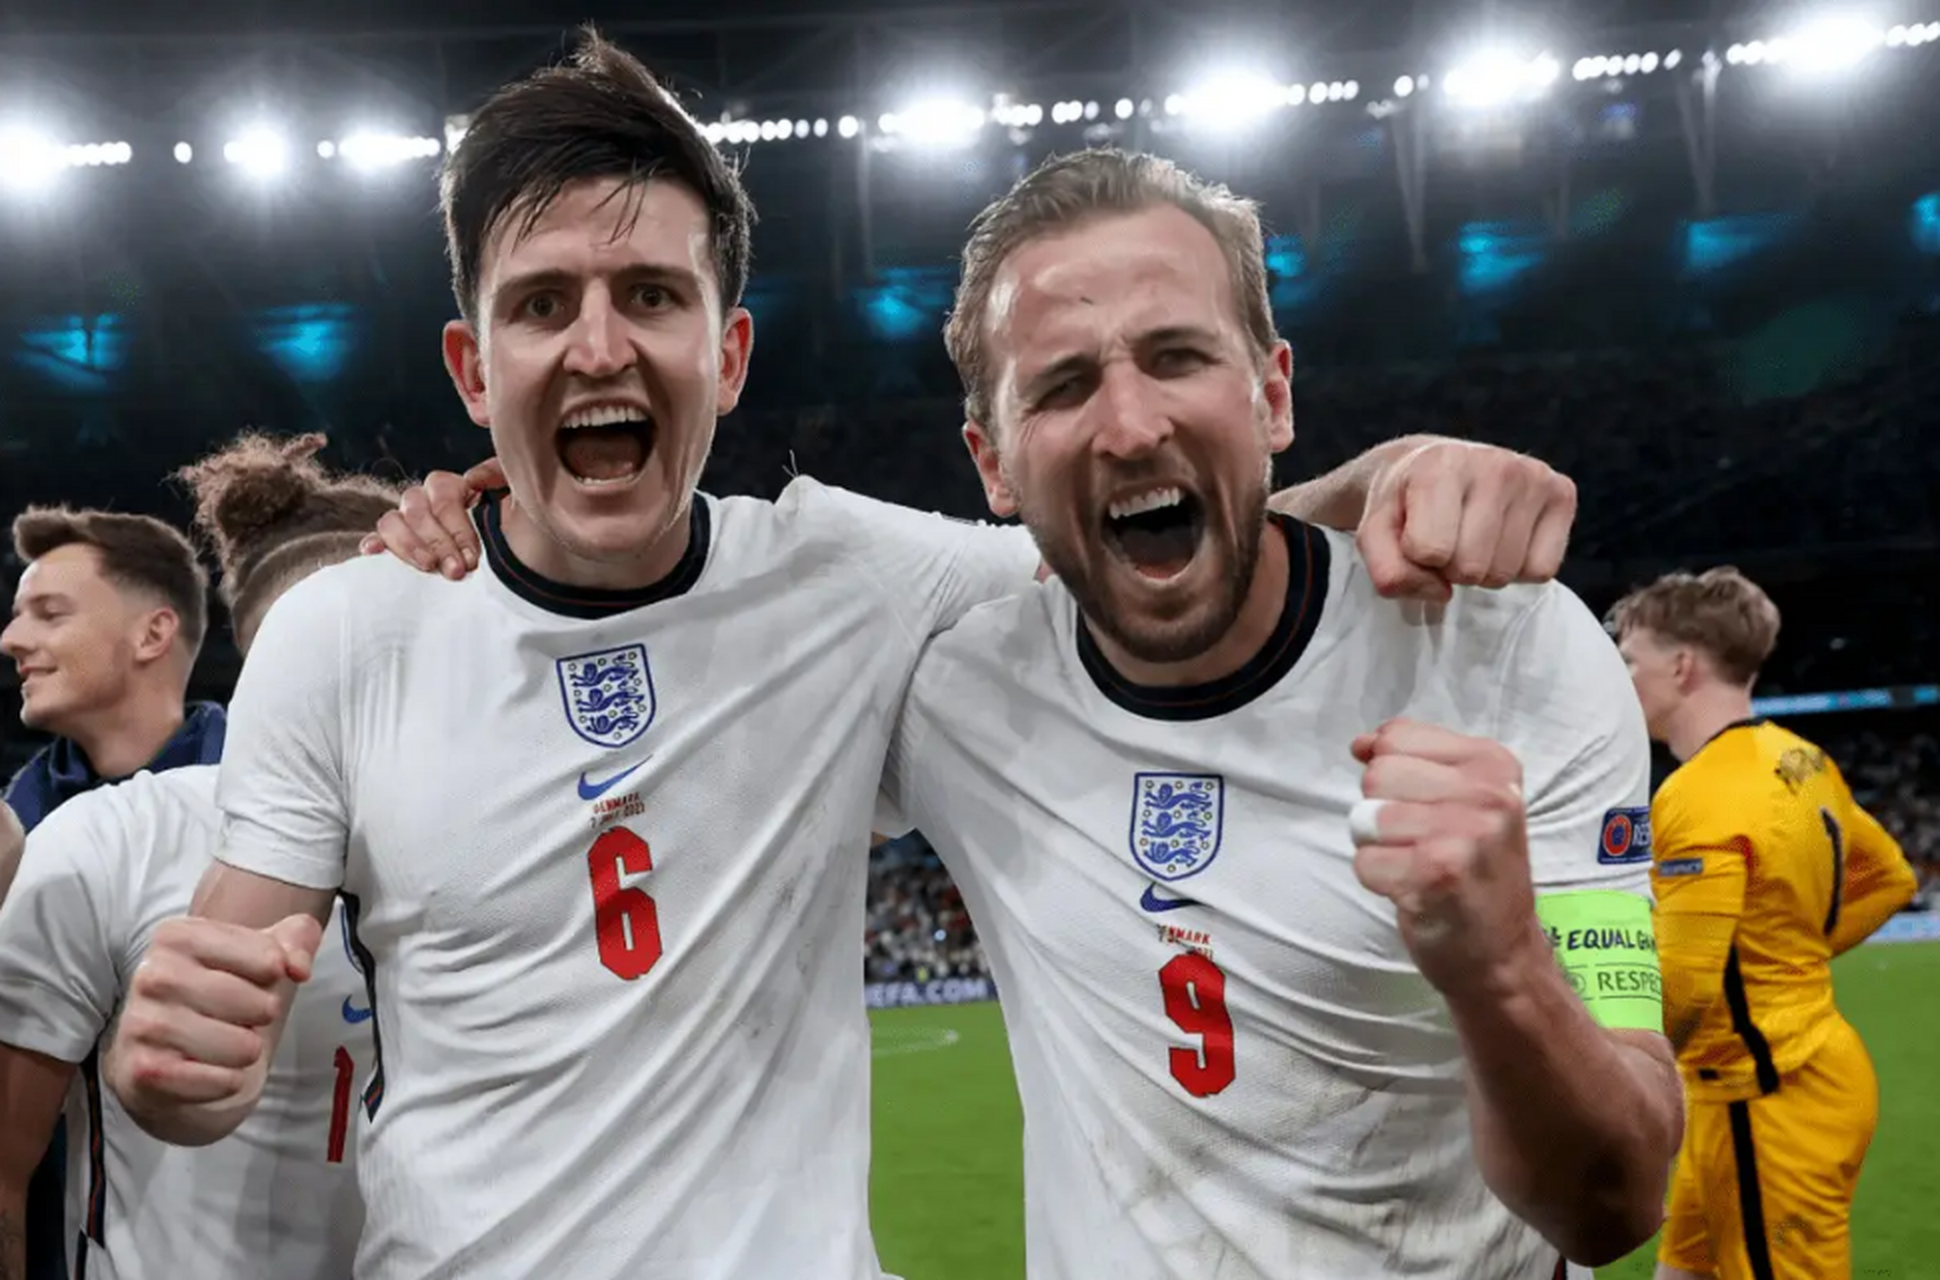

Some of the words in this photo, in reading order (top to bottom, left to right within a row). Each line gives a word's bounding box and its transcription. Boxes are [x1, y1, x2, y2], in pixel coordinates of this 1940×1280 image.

[587, 825, 663, 981] 6
[1820, 806, 1842, 936] 1
[1158, 953, 1236, 1098] 9
[326, 1044, 354, 1163] 1
